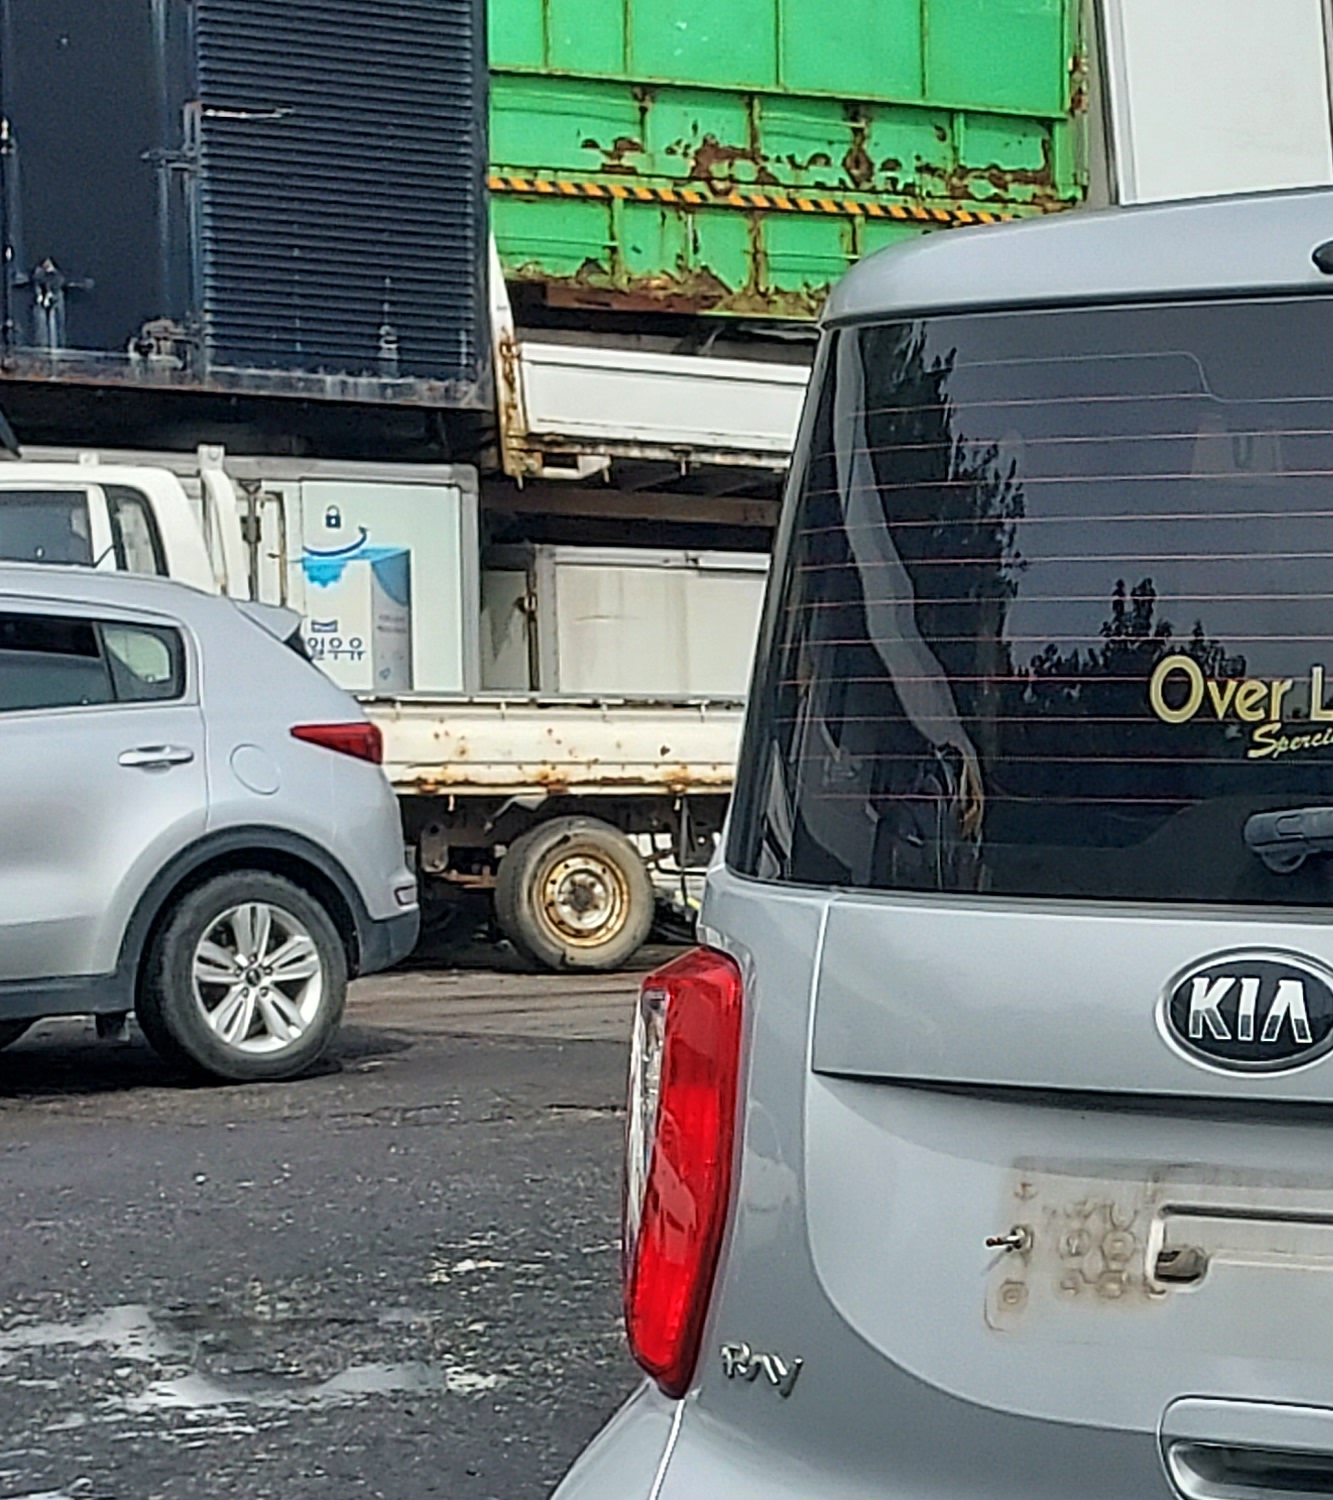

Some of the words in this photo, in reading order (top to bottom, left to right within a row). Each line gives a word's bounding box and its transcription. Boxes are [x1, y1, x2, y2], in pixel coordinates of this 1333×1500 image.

[306, 637, 366, 661] 일우유
[1150, 655, 1292, 723] Over
[1188, 977, 1313, 1043] KIA
